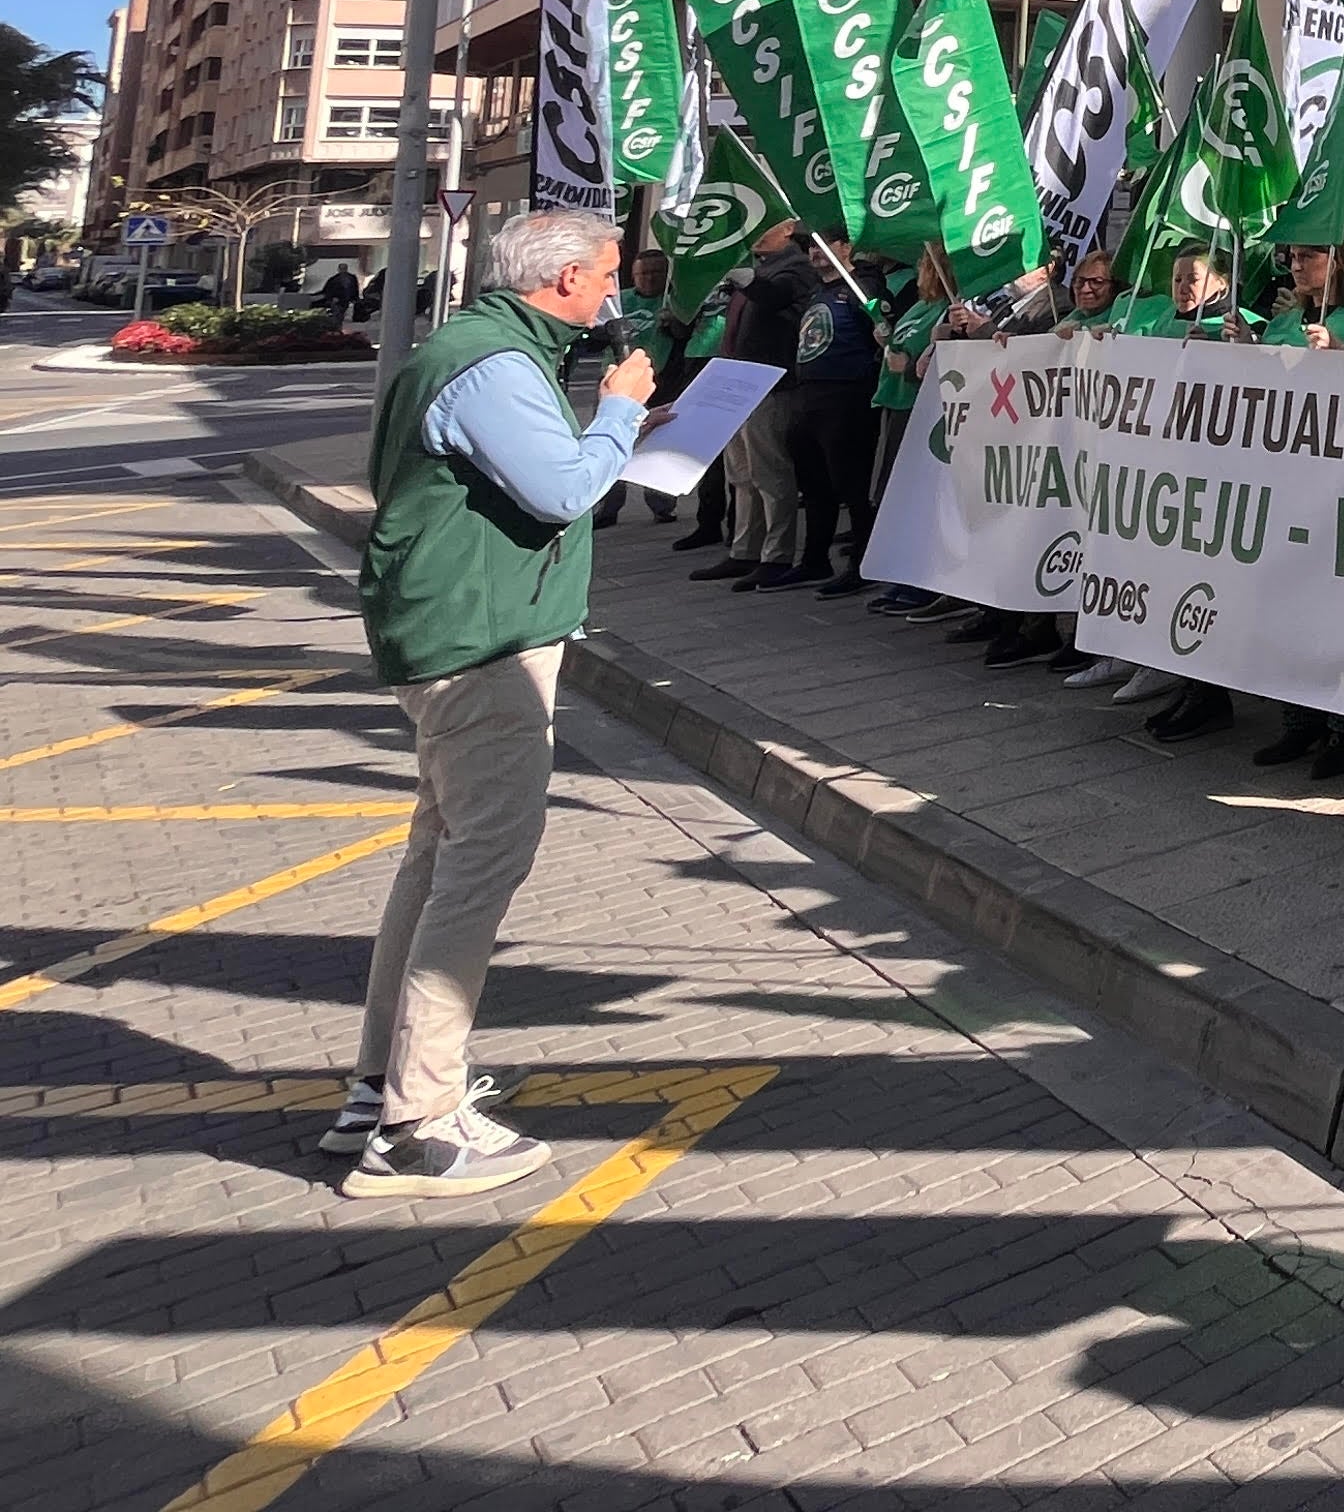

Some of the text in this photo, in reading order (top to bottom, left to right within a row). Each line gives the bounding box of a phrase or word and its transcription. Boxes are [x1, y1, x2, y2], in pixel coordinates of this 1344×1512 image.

[611, 11, 652, 130] CSIF
[833, 12, 901, 178] CSIF
[922, 35, 995, 216] CSIF
[813, 162, 834, 182] CS
[881, 180, 920, 204] CSIF
[979, 212, 1014, 241] CSIF
[1099, 376, 1156, 437] DEL
[1082, 572, 1150, 625] OD@S
[1179, 604, 1218, 635] CSIF
